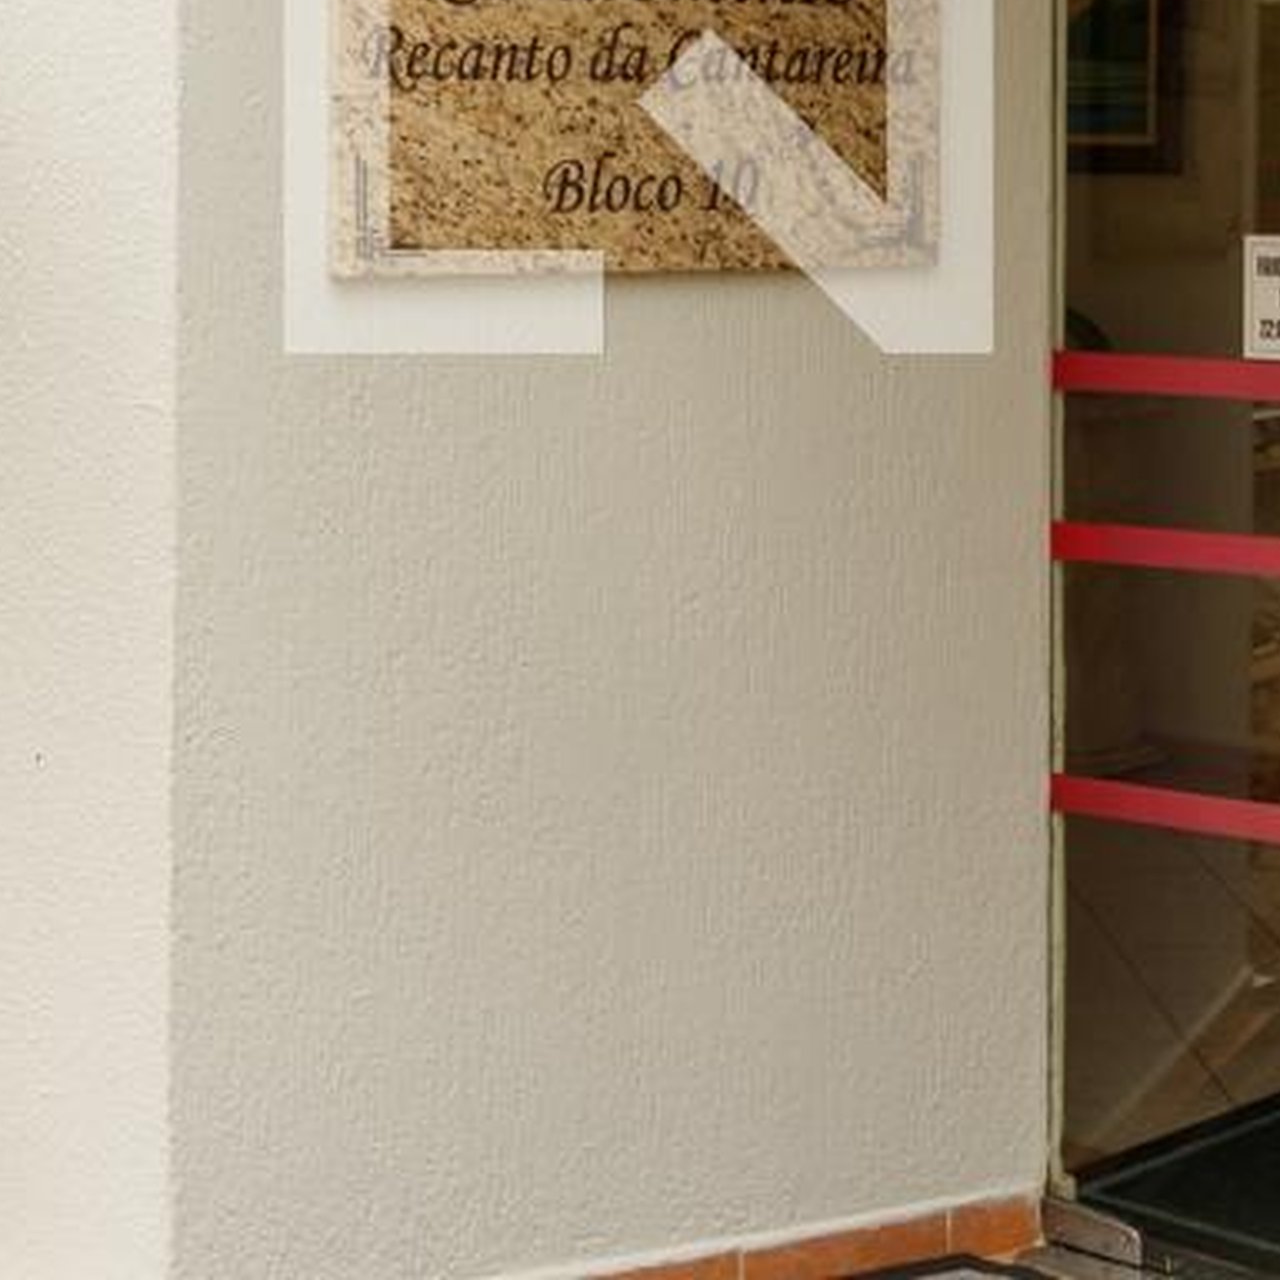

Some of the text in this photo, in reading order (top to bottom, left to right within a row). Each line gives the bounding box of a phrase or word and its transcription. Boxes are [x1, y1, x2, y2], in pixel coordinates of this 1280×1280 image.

[362, 21, 919, 94] Recanto da Cantareira
[542, 150, 760, 215] Bloco 10
